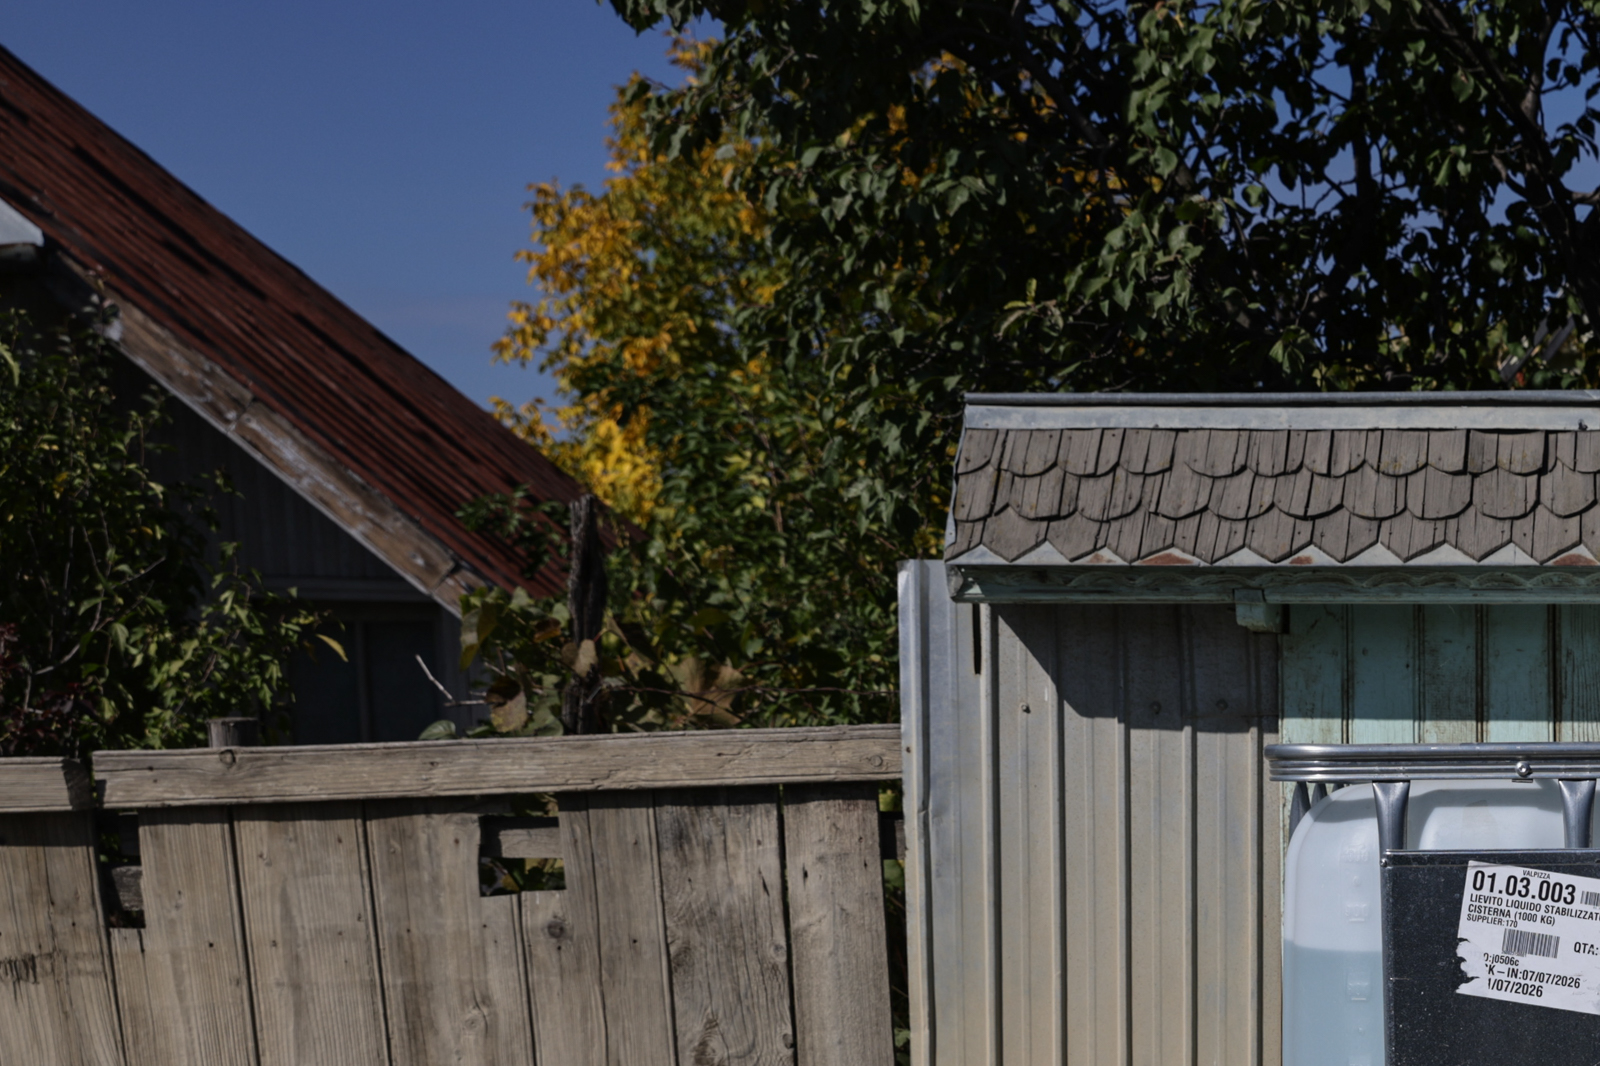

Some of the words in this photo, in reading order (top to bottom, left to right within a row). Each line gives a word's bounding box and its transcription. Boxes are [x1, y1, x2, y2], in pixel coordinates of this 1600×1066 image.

[1522, 869, 1551, 880] VALPIZZA
[1472, 870, 1577, 905] 01.03.003
[1470, 893, 1504, 907] LIEVITO
[1505, 898, 1542, 913] LIQUIDO
[1466, 912, 1518, 928] SUPPLIER:170
[1468, 903, 1511, 919] CISTERNA
[1514, 910, 1538, 924] (1000
[1540, 914, 1556, 927] KG)
